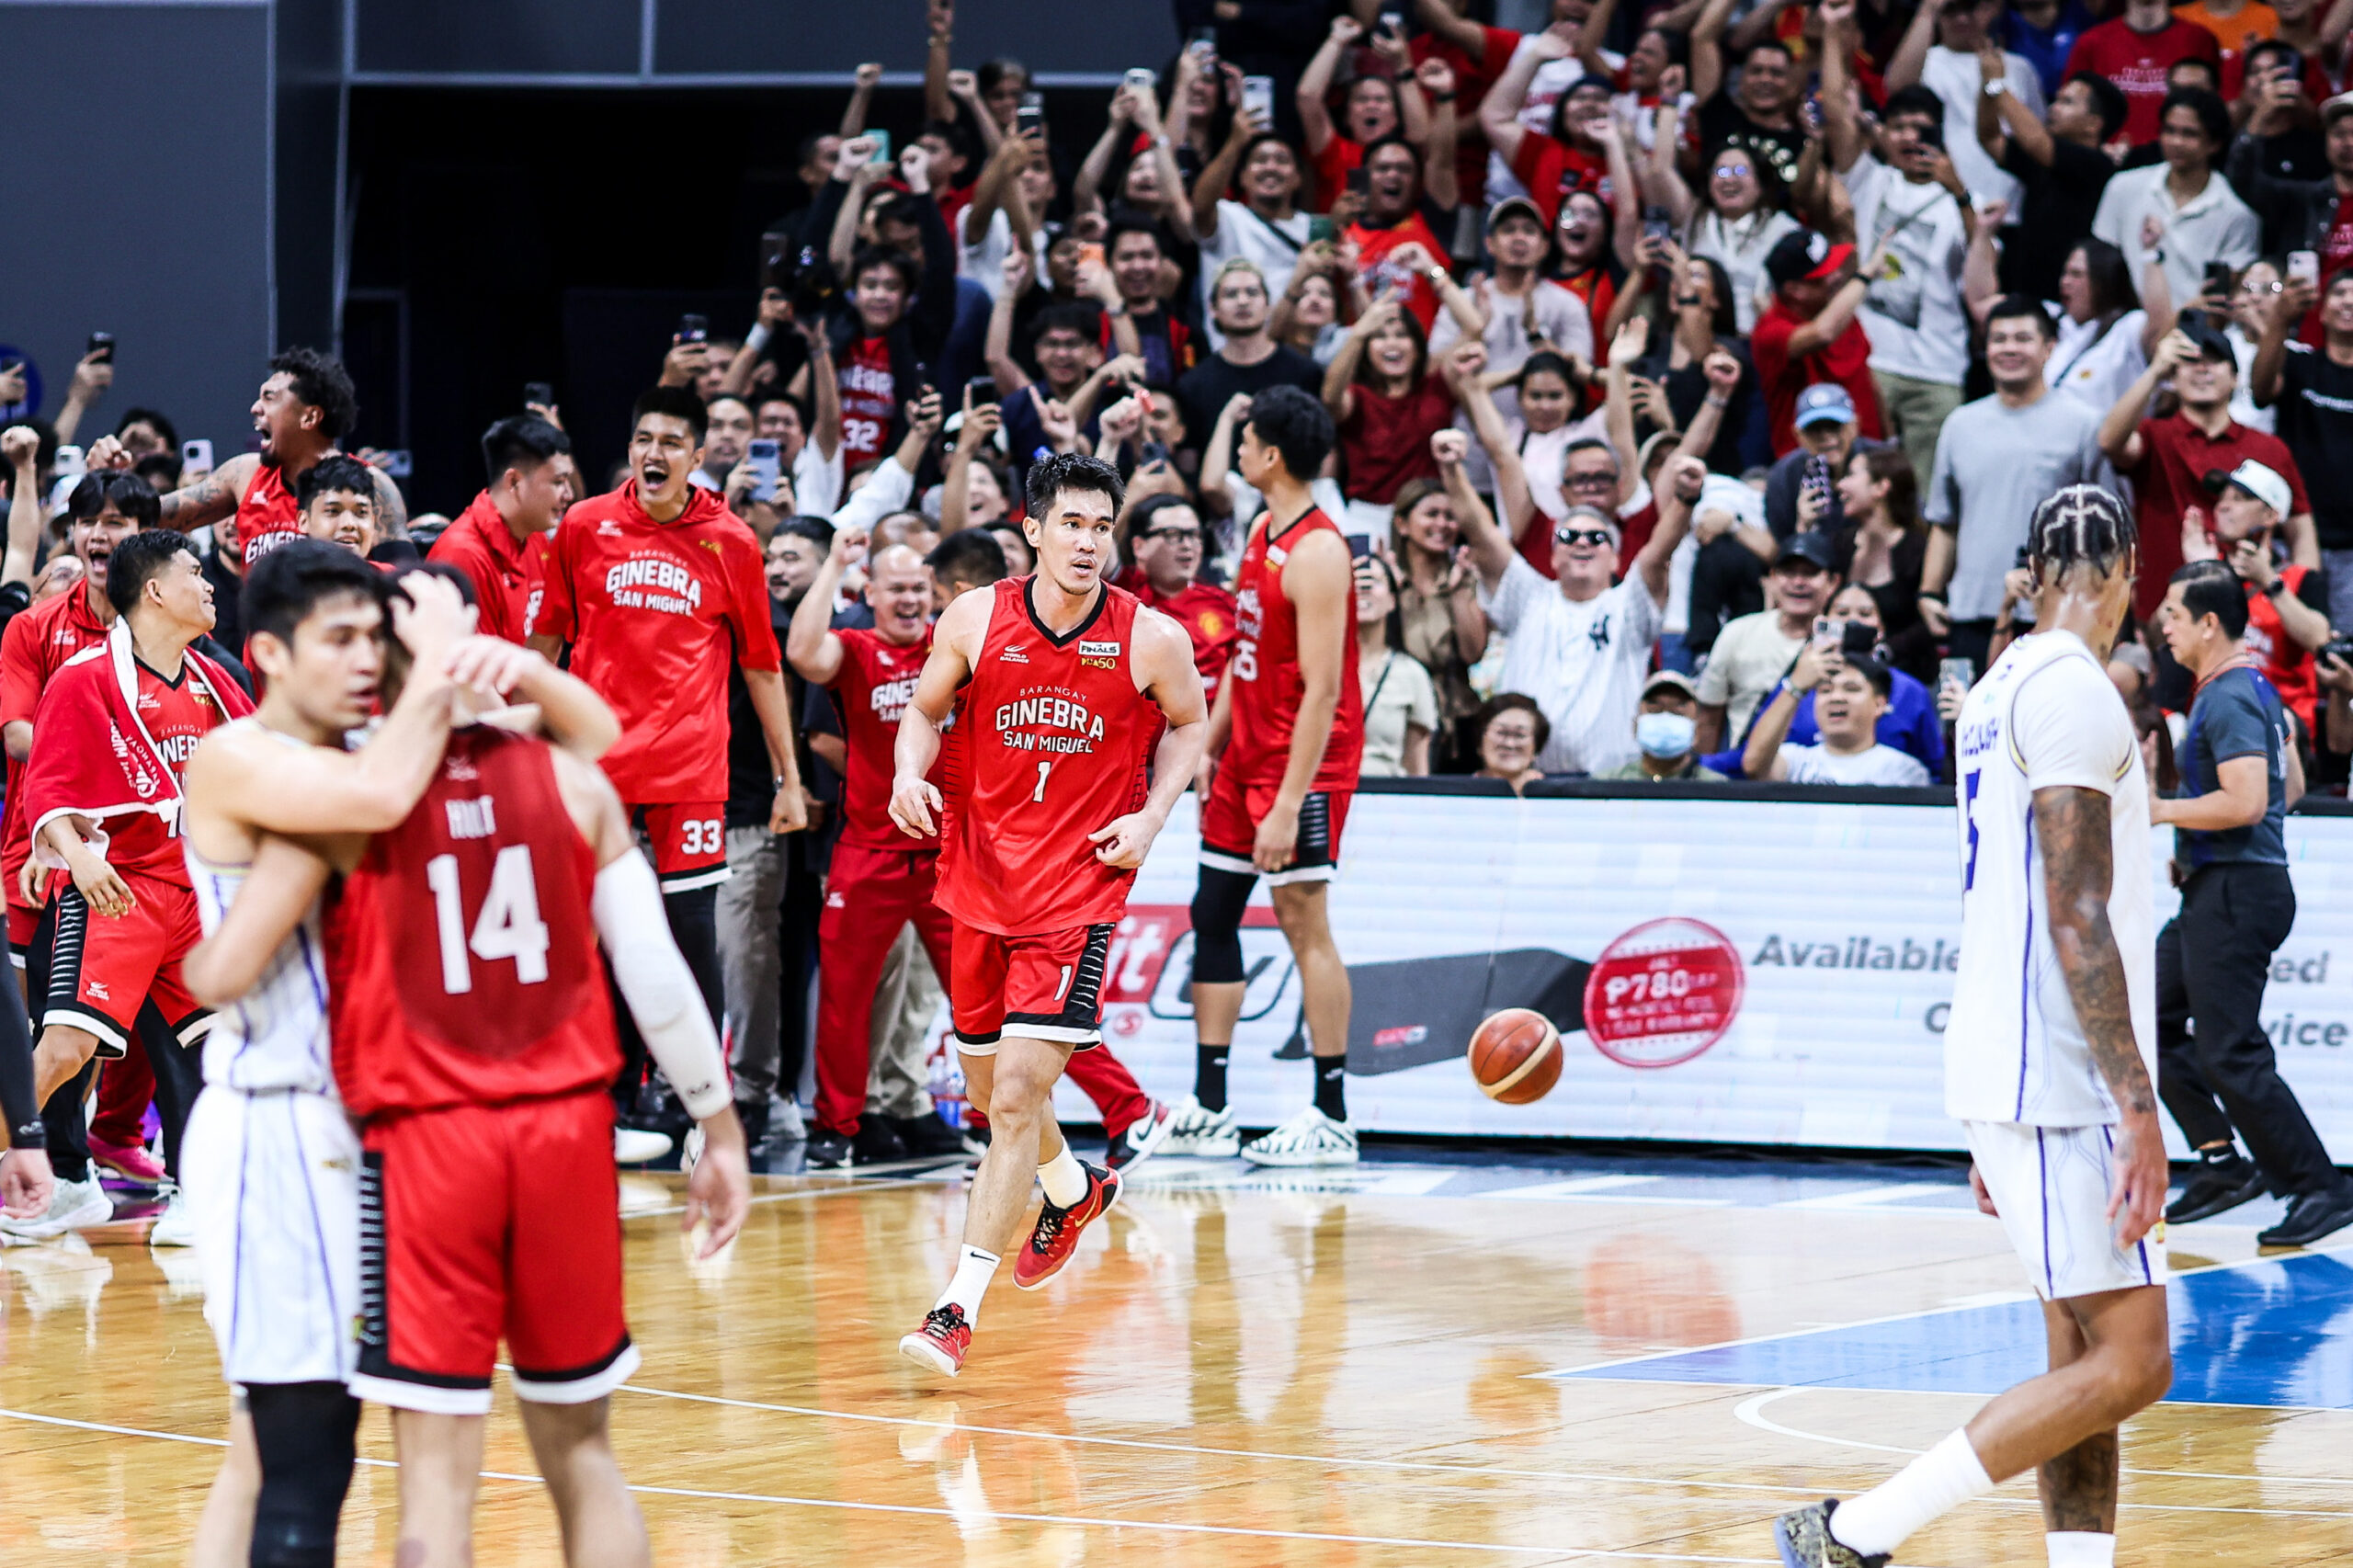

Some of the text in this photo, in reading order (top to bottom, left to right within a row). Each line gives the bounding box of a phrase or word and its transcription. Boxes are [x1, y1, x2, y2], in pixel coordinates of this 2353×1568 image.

[606, 559, 701, 608] GINEBRA
[613, 589, 642, 608] SAN
[1081, 645, 1117, 653] FINALS
[1020, 685, 1086, 702] BARANGAY
[995, 697, 1104, 742] GINEBRA
[1003, 731, 1094, 754] SAN MIGUEL
[1032, 761, 1051, 802] 1
[681, 819, 722, 855] 33
[426, 843, 550, 994] 14
[1053, 965, 1072, 1001] 1
